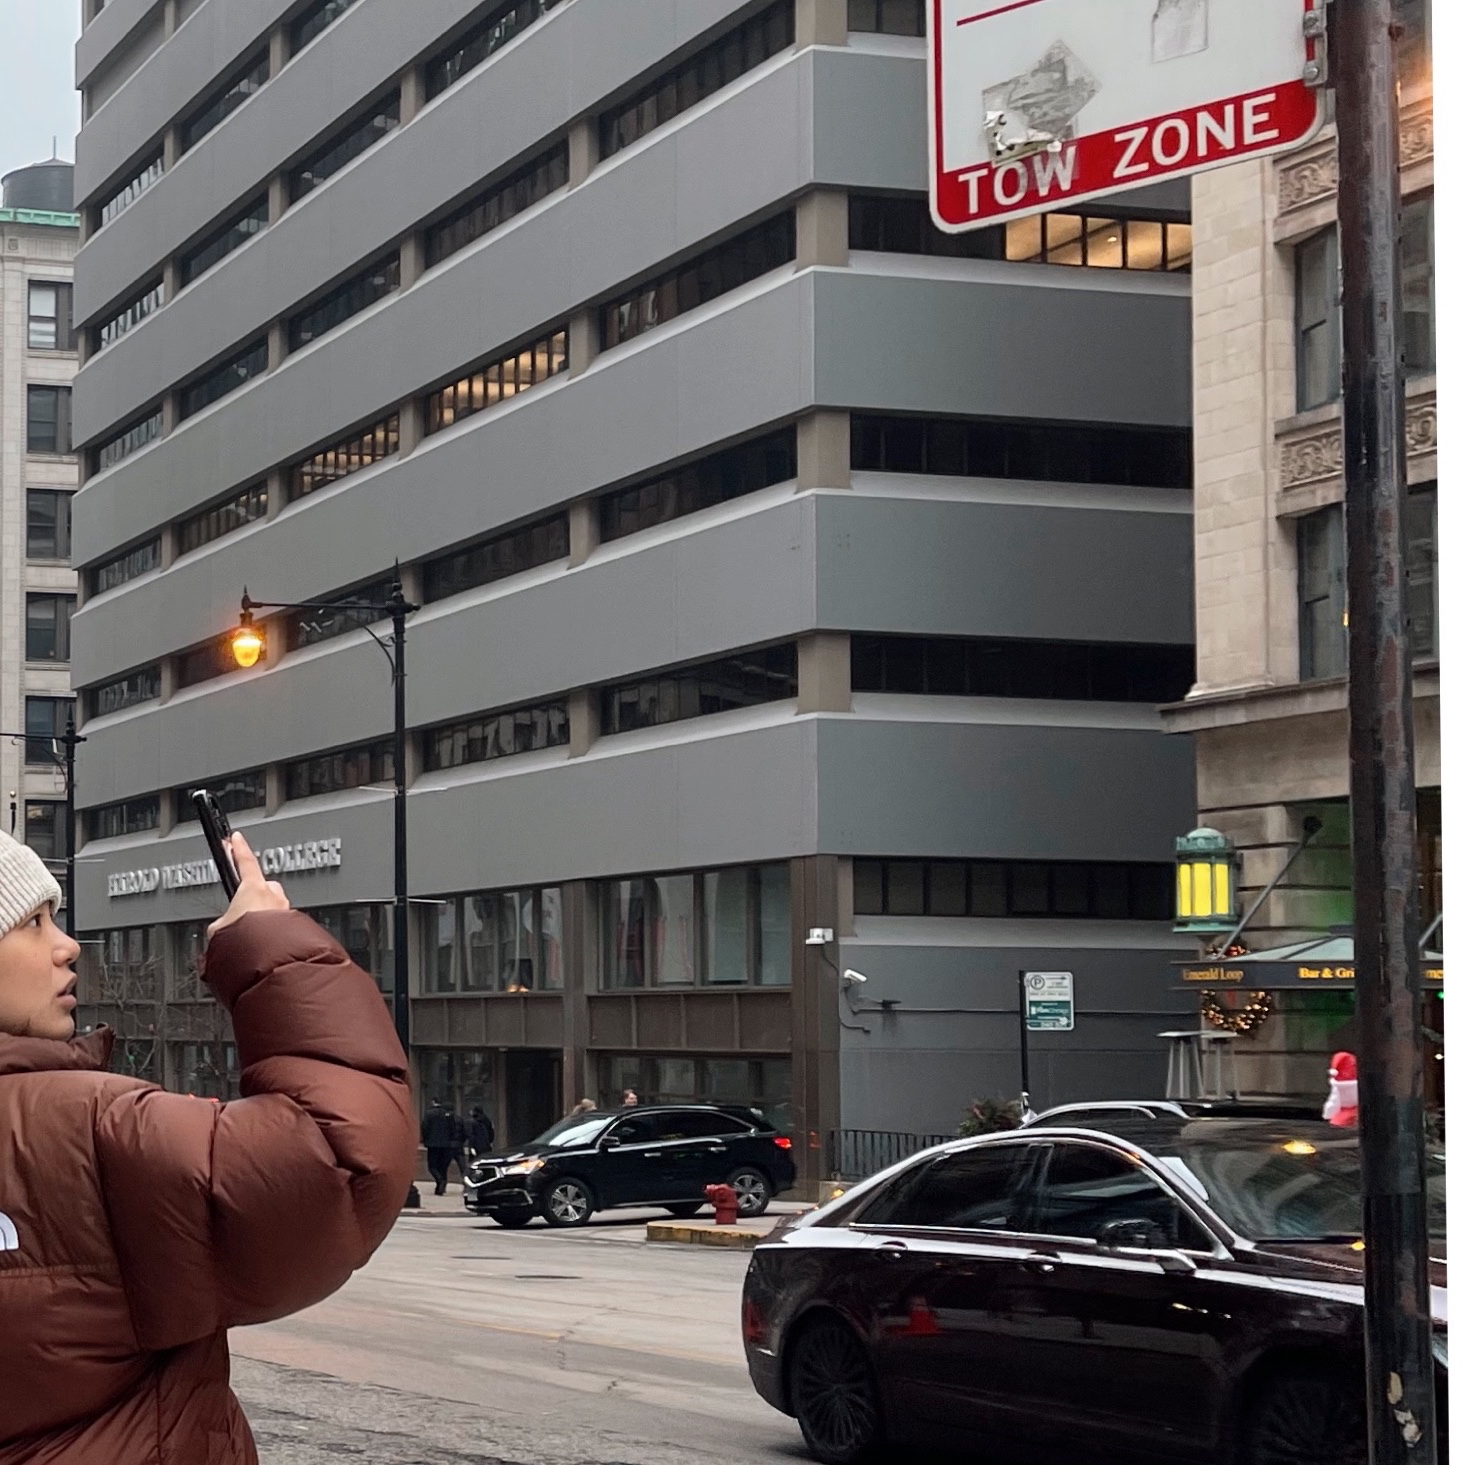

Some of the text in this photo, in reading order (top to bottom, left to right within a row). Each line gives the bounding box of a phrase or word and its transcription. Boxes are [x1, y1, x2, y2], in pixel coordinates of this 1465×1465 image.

[958, 92, 1280, 215] TOW ZONE
[262, 838, 342, 875] COLLEGE
[1220, 967, 1244, 982] Loop
[1298, 966, 1355, 979] Bar & Gri
